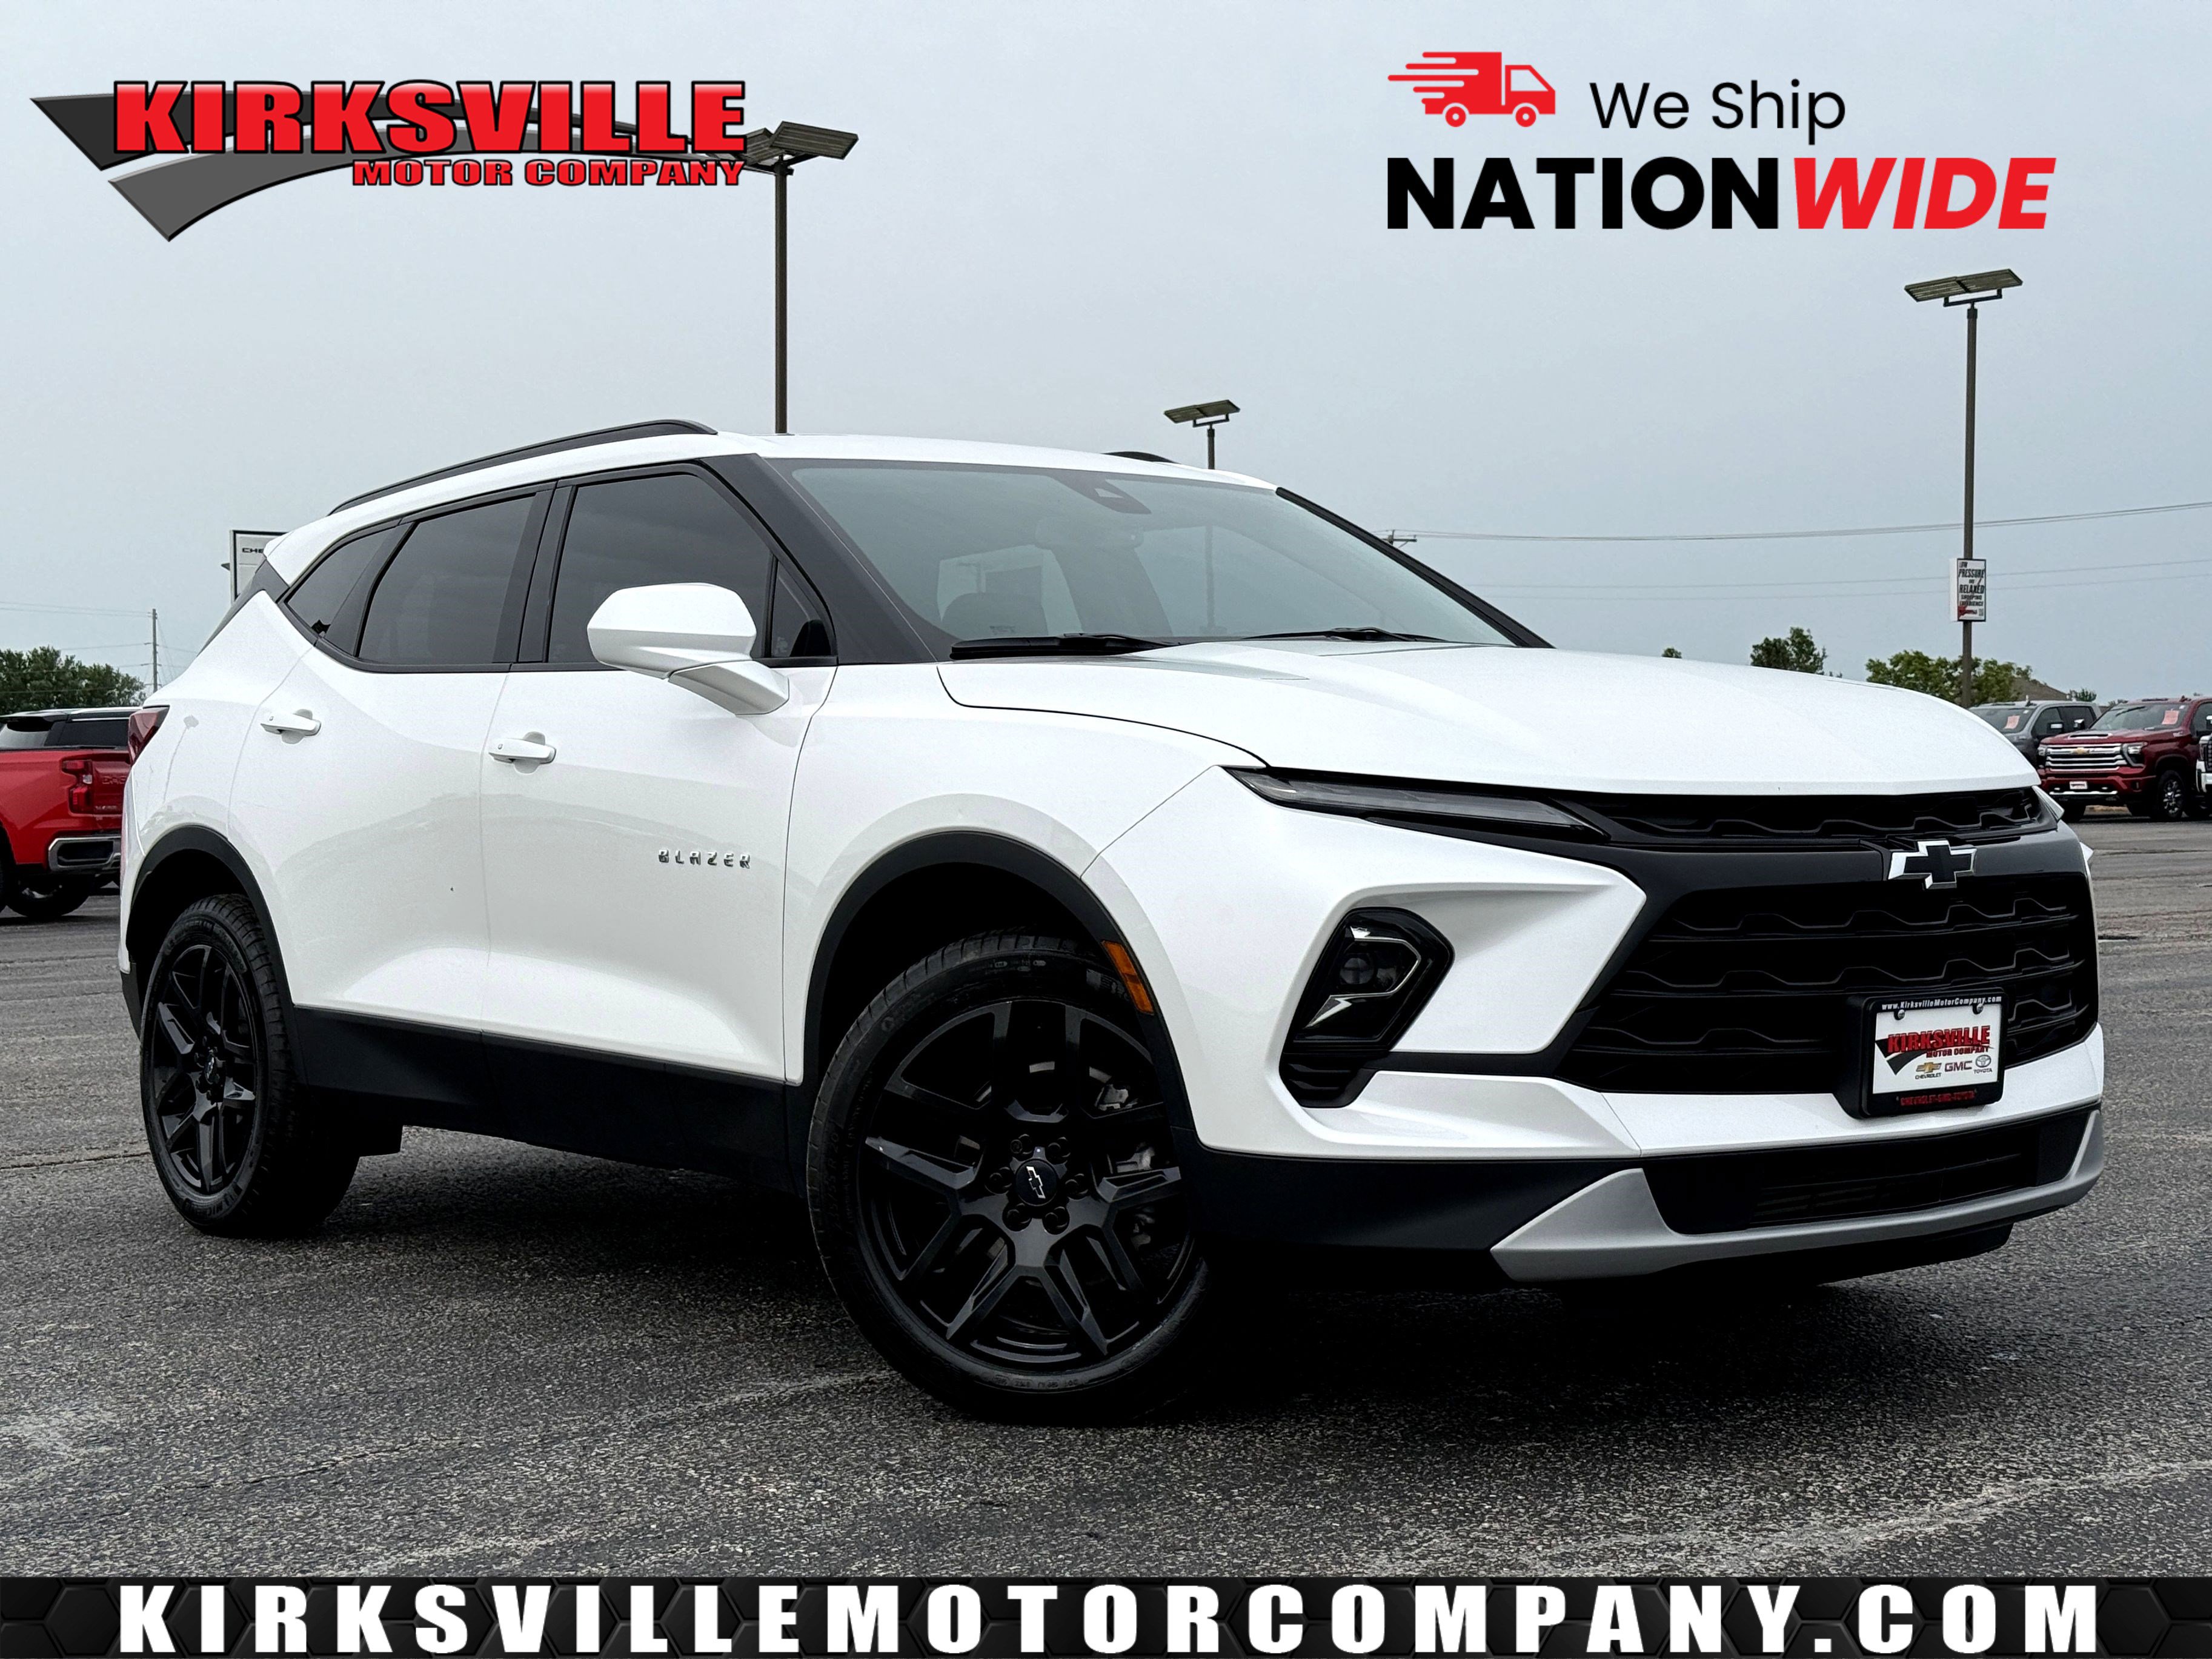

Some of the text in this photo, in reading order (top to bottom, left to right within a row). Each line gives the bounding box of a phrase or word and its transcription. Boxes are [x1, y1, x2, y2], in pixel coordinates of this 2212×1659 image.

[1959, 584, 1985, 594] RELAXED
[658, 848, 751, 869] BLAZER
[1887, 1025, 1991, 1055] KIRKSVILLE
[1926, 1045, 1990, 1059] MOTOR COMPANY
[1944, 1060, 1973, 1072] GMC
